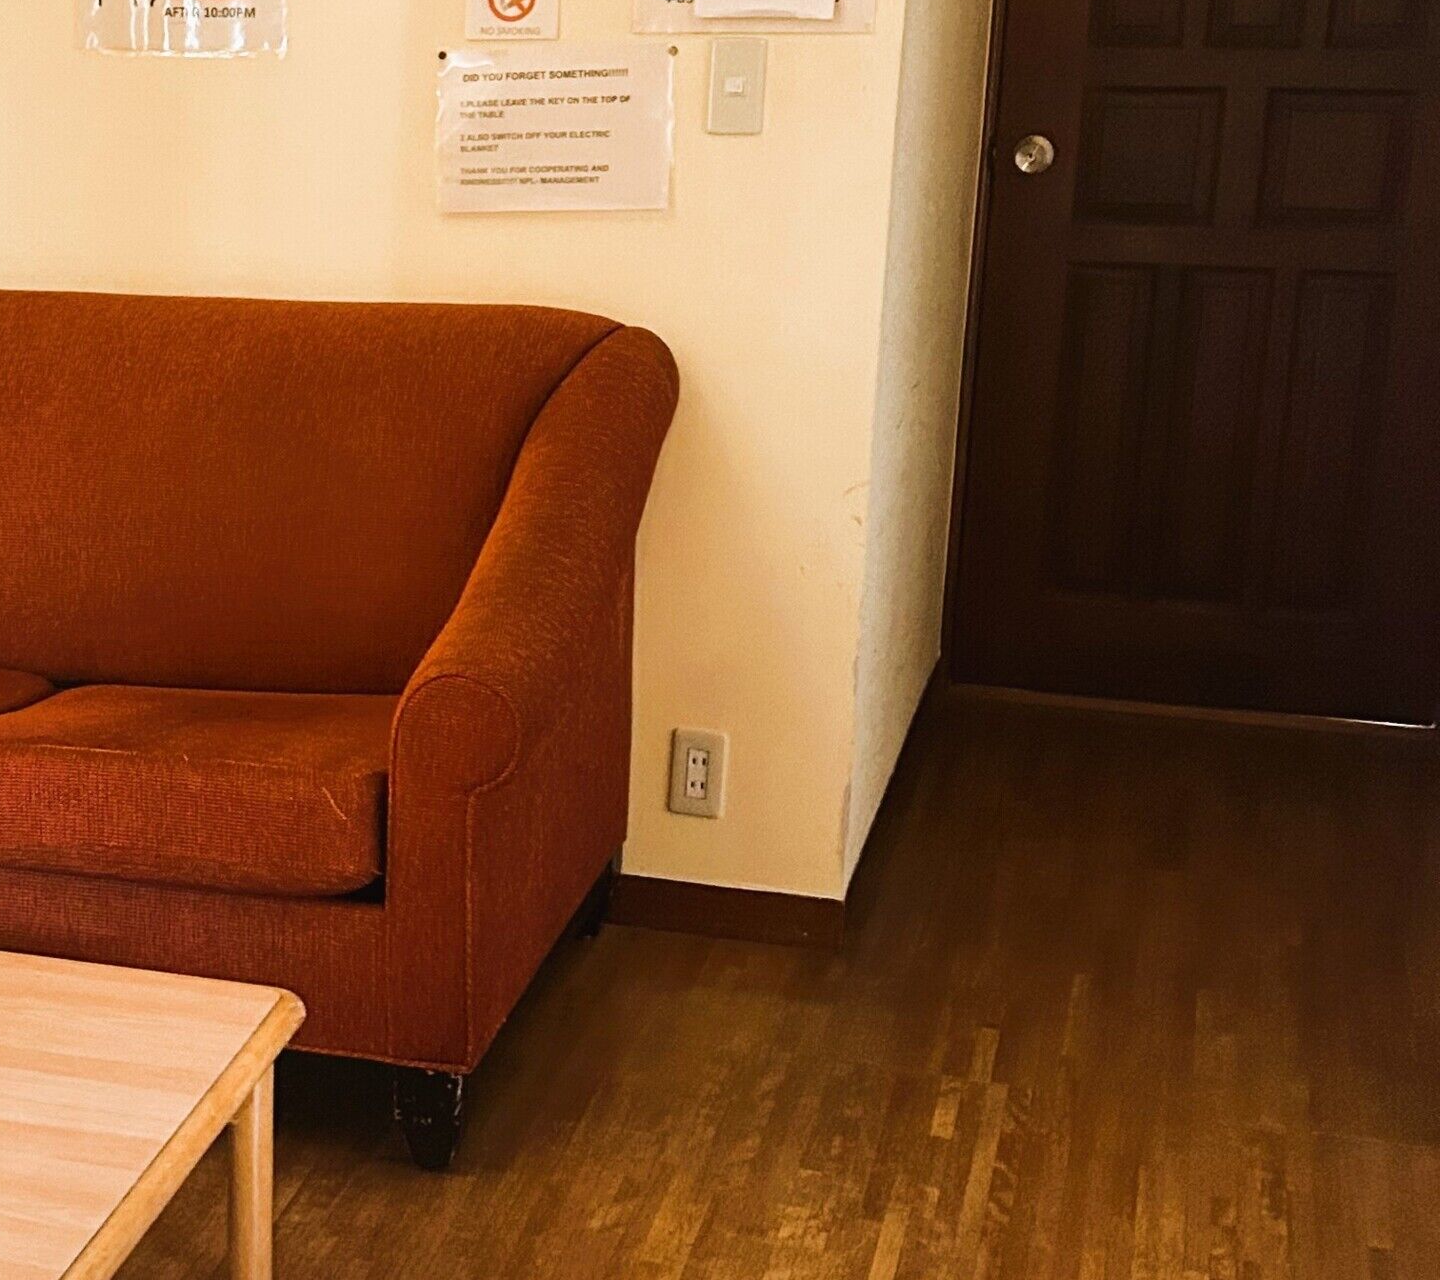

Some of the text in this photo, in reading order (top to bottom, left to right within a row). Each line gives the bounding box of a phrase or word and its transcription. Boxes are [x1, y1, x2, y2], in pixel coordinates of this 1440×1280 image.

[165, 7, 256, 18] AFTR 10:00PM
[463, 74, 480, 83] DID
[482, 73, 503, 81] YOU
[505, 71, 546, 80] FORGET
[501, 98, 527, 107] LEAVE
[530, 97, 545, 106] THE
[548, 97, 565, 105] KEY
[567, 96, 579, 104] ON
[583, 96, 598, 104] THE
[600, 95, 618, 103] TOP
[620, 95, 630, 103] OF
[492, 131, 523, 141] SWITCH
[525, 131, 541, 140] OFF
[544, 131, 567, 139] YOUR
[569, 130, 611, 138] ELECTRIC
[529, 165, 588, 173] COOPERATING
